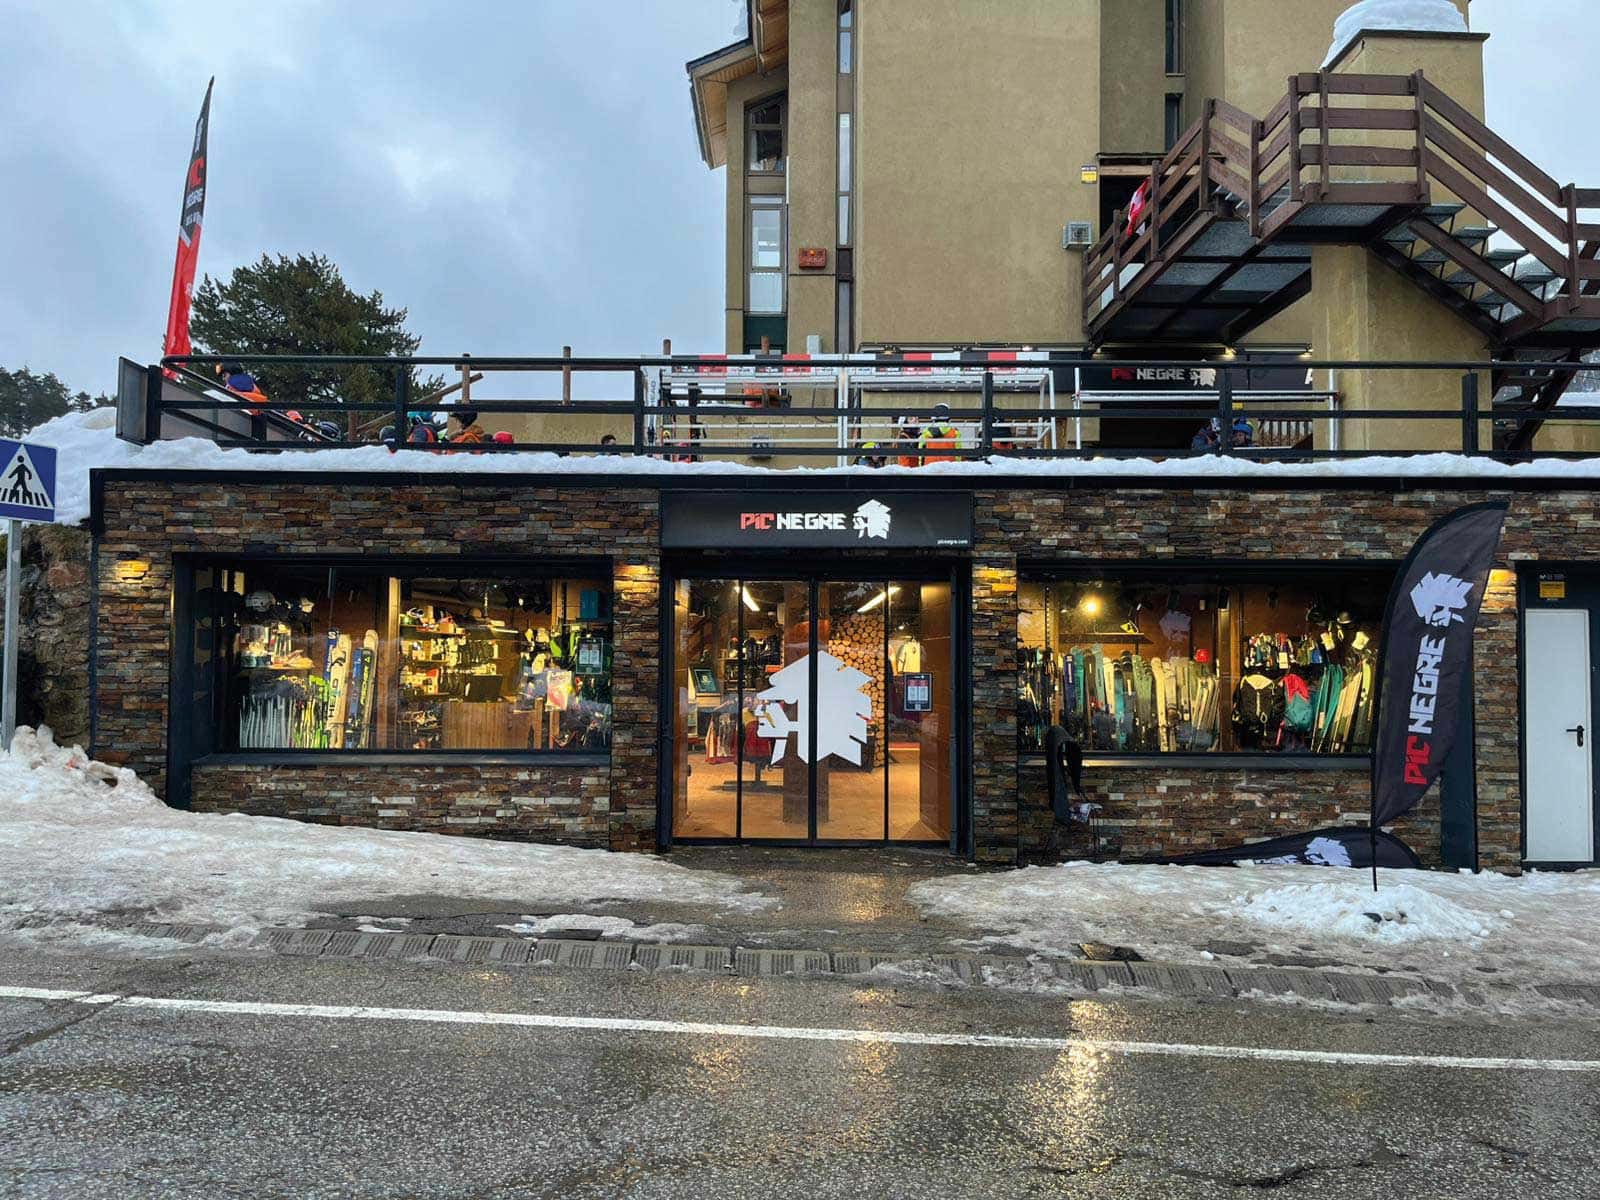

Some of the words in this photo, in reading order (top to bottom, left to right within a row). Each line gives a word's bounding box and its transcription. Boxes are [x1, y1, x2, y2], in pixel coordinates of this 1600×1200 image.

[1136, 368, 1185, 380] NEGRE
[776, 512, 847, 530] NEGRE
[1407, 634, 1446, 734] NEGRE
